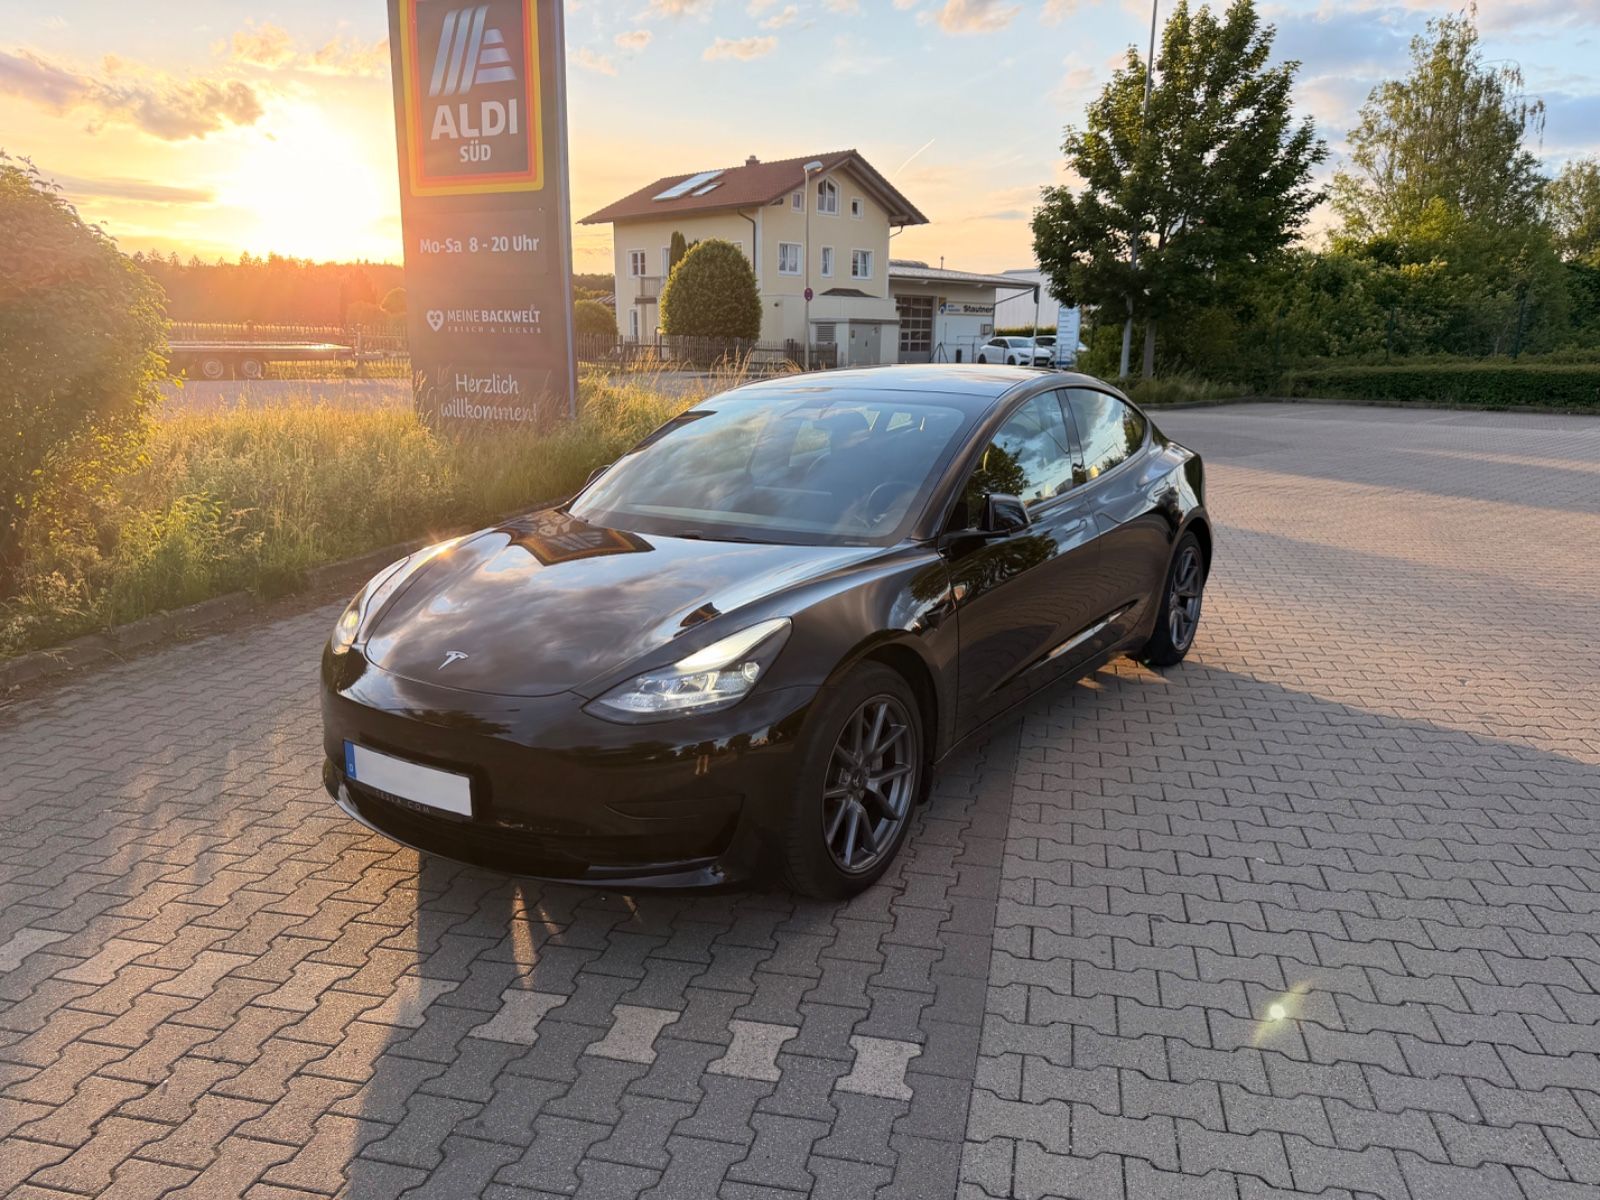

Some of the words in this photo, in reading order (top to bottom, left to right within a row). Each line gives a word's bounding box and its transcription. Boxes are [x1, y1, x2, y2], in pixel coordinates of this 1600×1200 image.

[431, 99, 518, 140] ALDI
[460, 140, 491, 162] SÜD
[420, 238, 462, 253] Mo-Sa
[469, 236, 479, 252] 8
[491, 236, 509, 252] 20
[512, 234, 539, 252] Uhr
[448, 310, 480, 322] MEINE
[481, 309, 541, 323] BACKWELT
[455, 372, 519, 394] Herzlich
